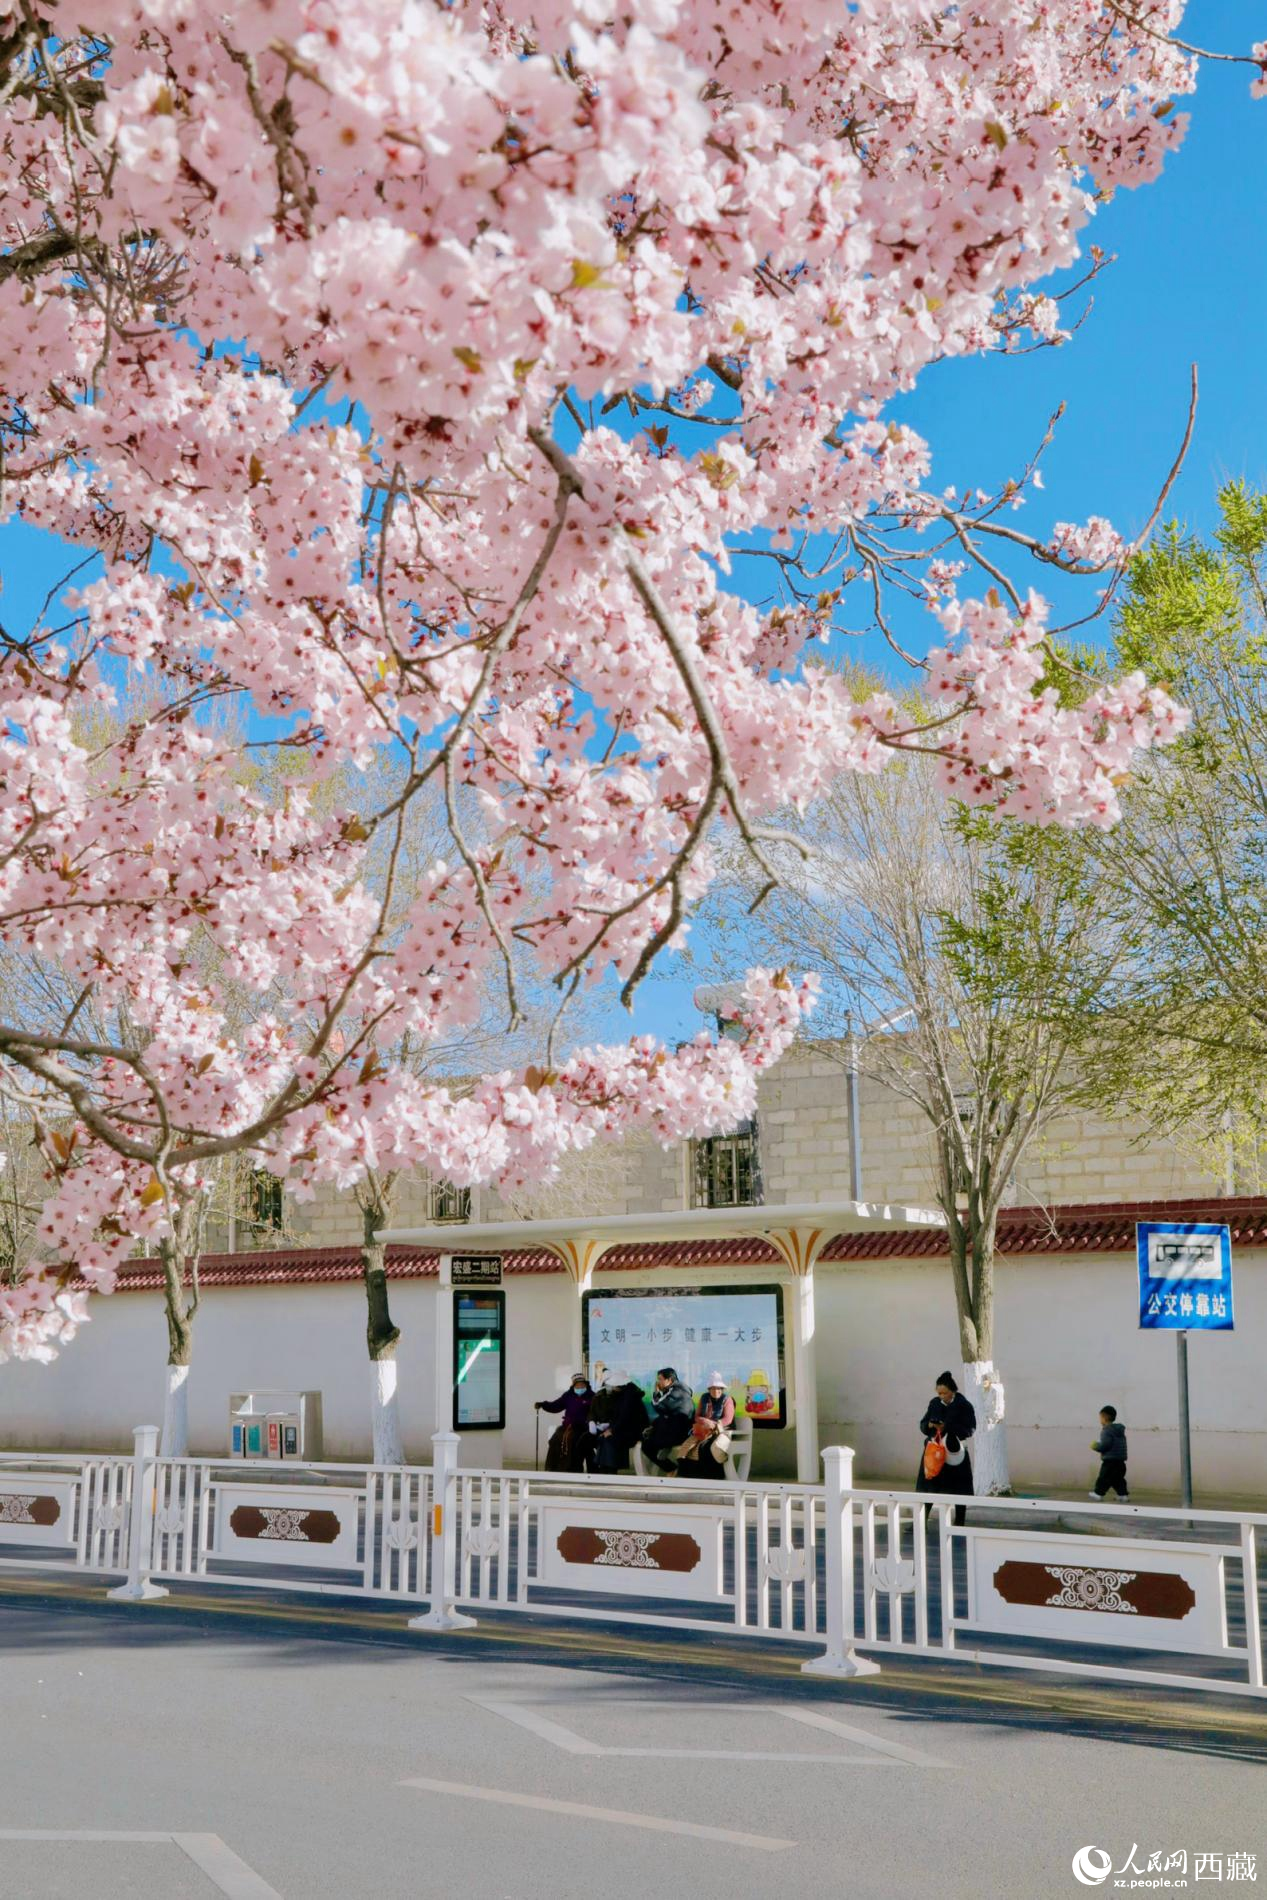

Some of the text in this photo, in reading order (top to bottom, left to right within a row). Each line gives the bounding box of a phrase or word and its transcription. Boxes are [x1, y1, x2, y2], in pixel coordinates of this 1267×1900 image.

[1148, 1292, 1226, 1317] 公交停靠站
[601, 1327, 762, 1343] 文明一小步 健康一大步
